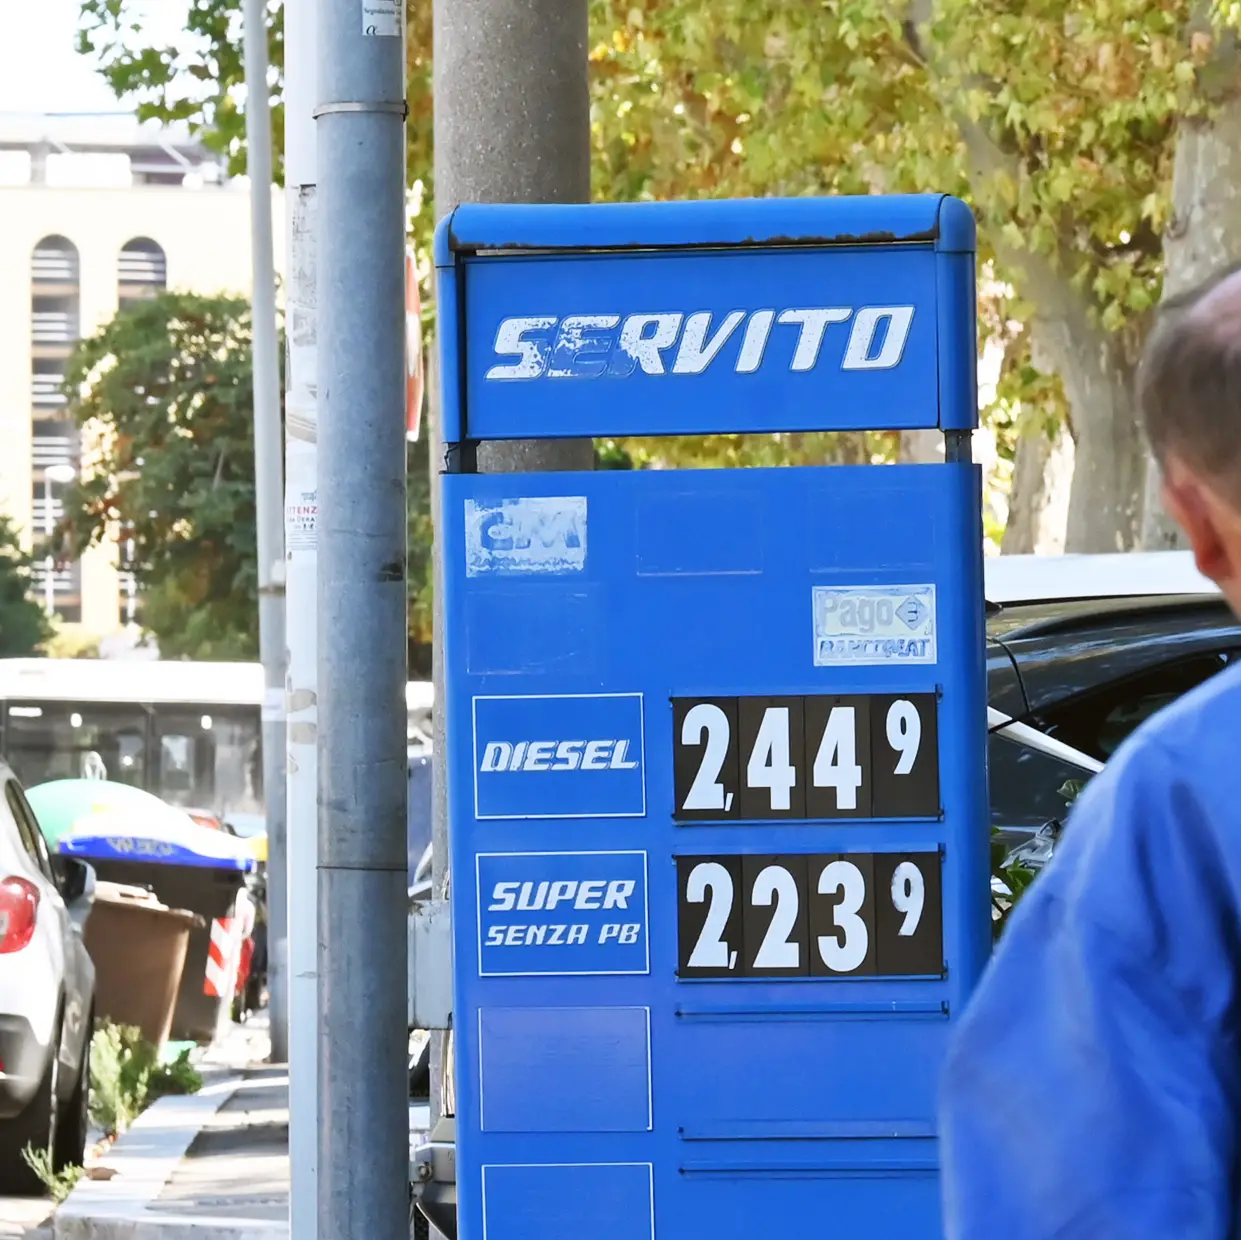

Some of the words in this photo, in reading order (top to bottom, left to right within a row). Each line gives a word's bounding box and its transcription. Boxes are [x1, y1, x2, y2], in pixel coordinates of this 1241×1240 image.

[484, 306, 916, 380] SERVITO
[823, 594, 895, 634] Pago
[480, 740, 640, 772] DIESEL
[488, 880, 636, 912] SUPER
[484, 924, 589, 946] SENZA
[597, 923, 641, 944] PB
